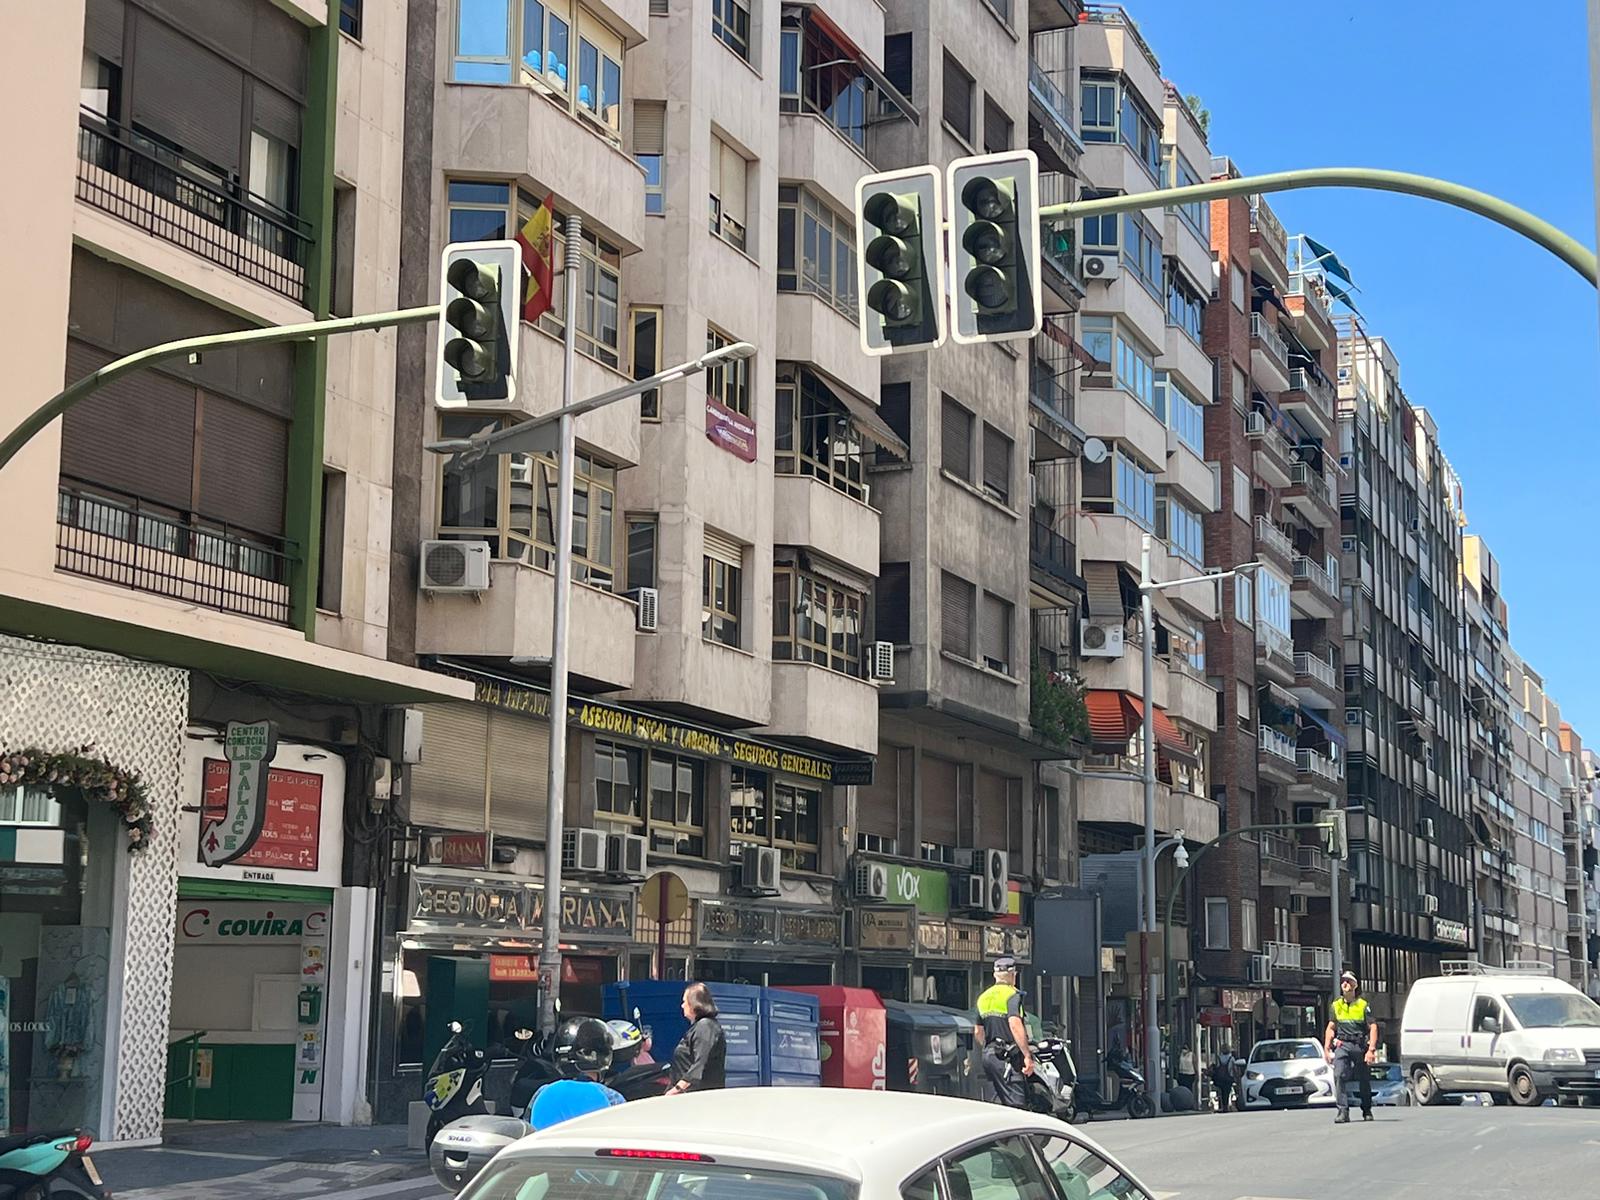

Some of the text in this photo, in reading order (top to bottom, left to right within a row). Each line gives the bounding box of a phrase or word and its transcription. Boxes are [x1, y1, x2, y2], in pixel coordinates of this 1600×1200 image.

[231, 726, 265, 736] CENTRO
[227, 736, 267, 746] COMERCIAL
[580, 704, 632, 735] ASESORIA
[636, 716, 668, 743] FISCAL
[671, 726, 678, 745] Y
[680, 728, 719, 755] LABORAL
[733, 742, 779, 768] SEGUROS
[781, 753, 832, 780] GENERALES
[232, 747, 262, 761] LIS
[224, 762, 251, 850] PALACE
[243, 871, 274, 881] ENTRADA
[897, 867, 920, 901] VOX
[531, 891, 629, 929] MRIANA
[23, 1021, 50, 1032] LOOKS
